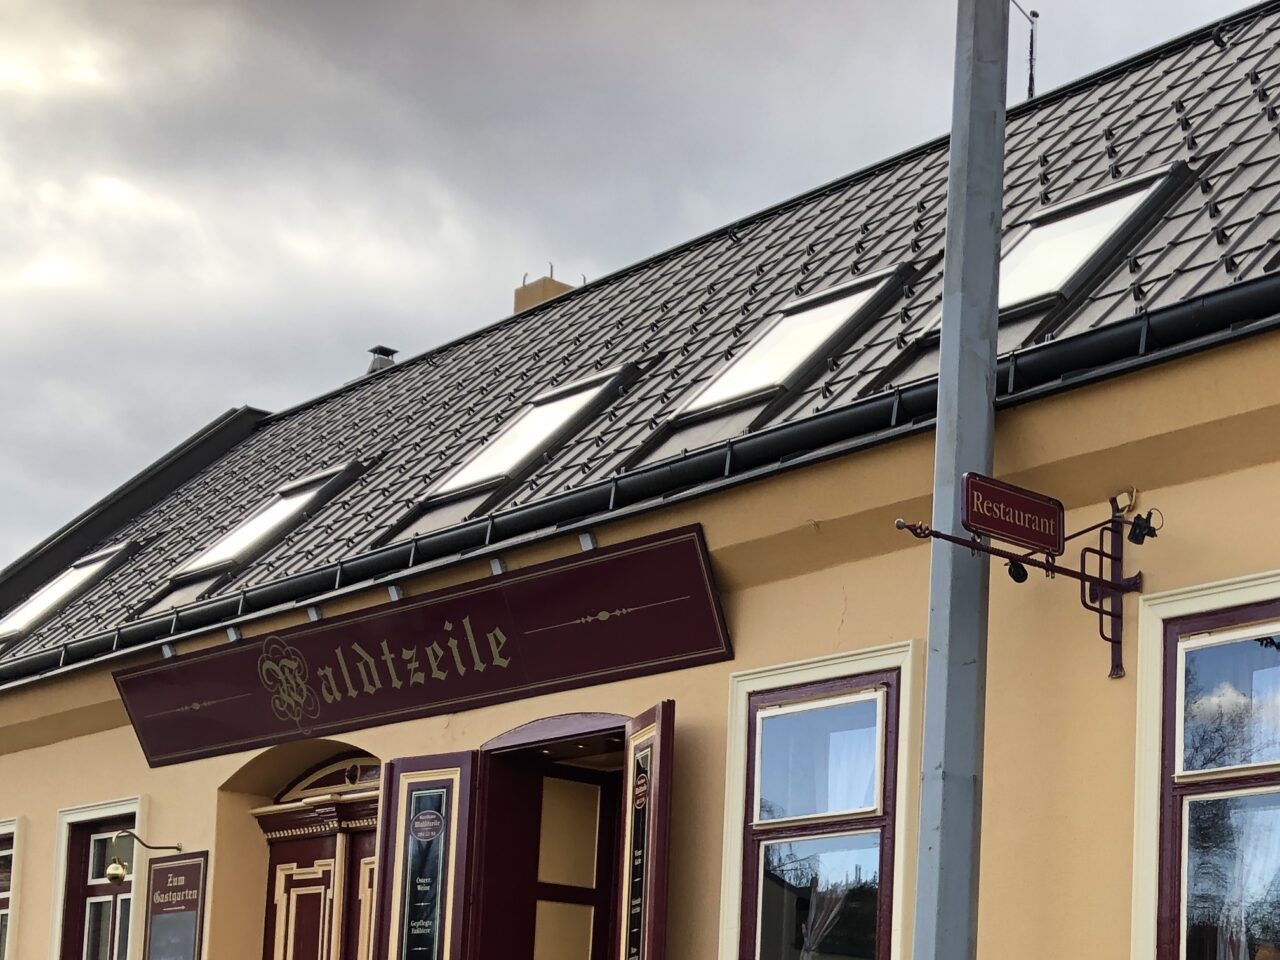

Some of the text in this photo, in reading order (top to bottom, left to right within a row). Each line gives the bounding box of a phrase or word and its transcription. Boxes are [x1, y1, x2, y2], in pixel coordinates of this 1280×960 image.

[972, 490, 1056, 536] Restaurant
[260, 616, 512, 718] Waldtzeile
[167, 873, 185, 887] Zum
[153, 889, 198, 904] Gastgarten
